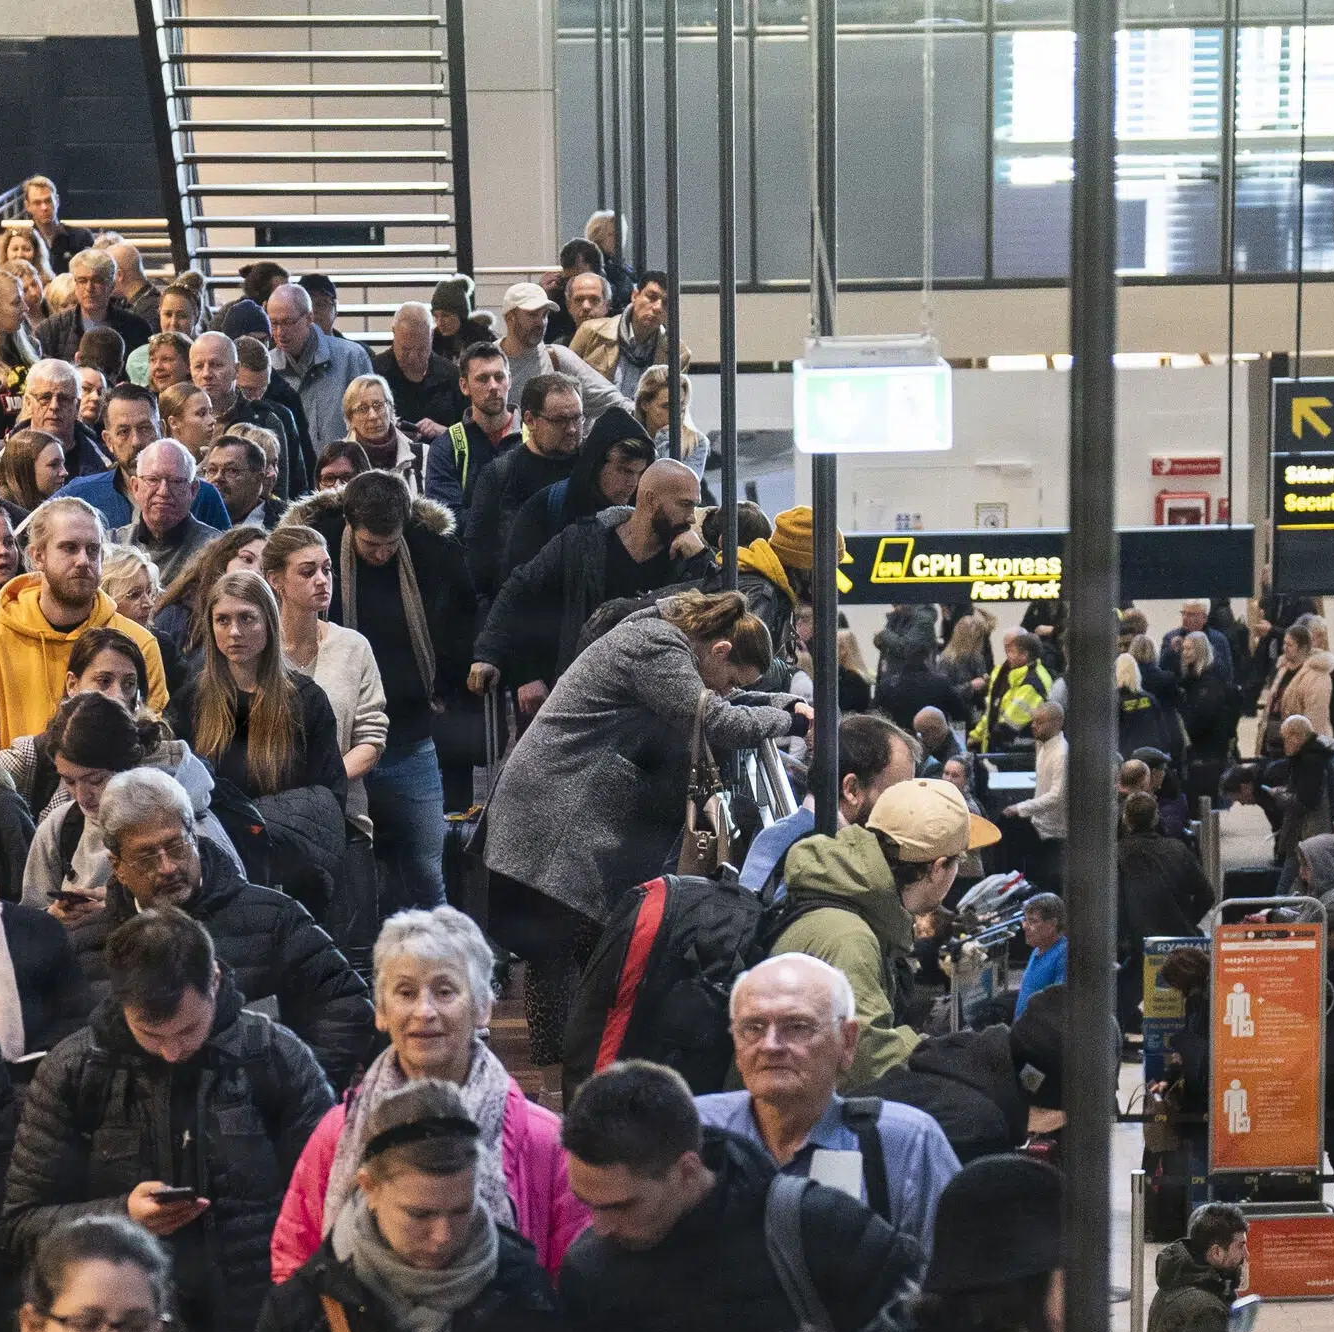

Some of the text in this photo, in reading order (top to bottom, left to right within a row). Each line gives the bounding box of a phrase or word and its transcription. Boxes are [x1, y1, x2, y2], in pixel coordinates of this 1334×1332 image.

[912, 553, 1062, 579] CPH Express
[970, 579, 1061, 600] Fast Track
